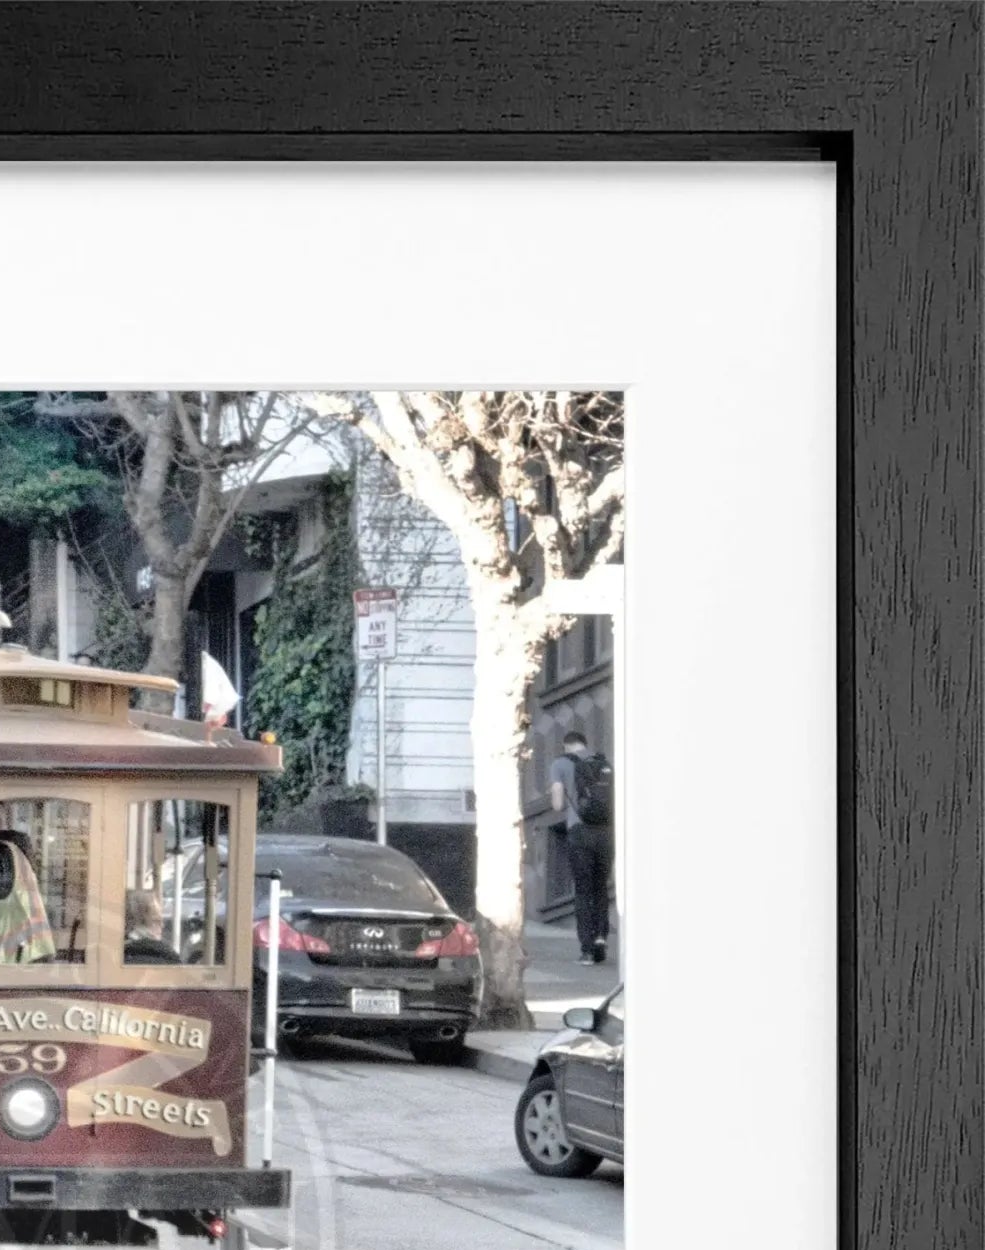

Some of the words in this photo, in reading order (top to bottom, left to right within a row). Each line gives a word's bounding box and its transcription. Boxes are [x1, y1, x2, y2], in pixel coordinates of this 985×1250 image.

[369, 621, 386, 631] ANY
[368, 634, 387, 645] TIME
[64, 1005, 205, 1049] California
[91, 1089, 212, 1128] Streets
